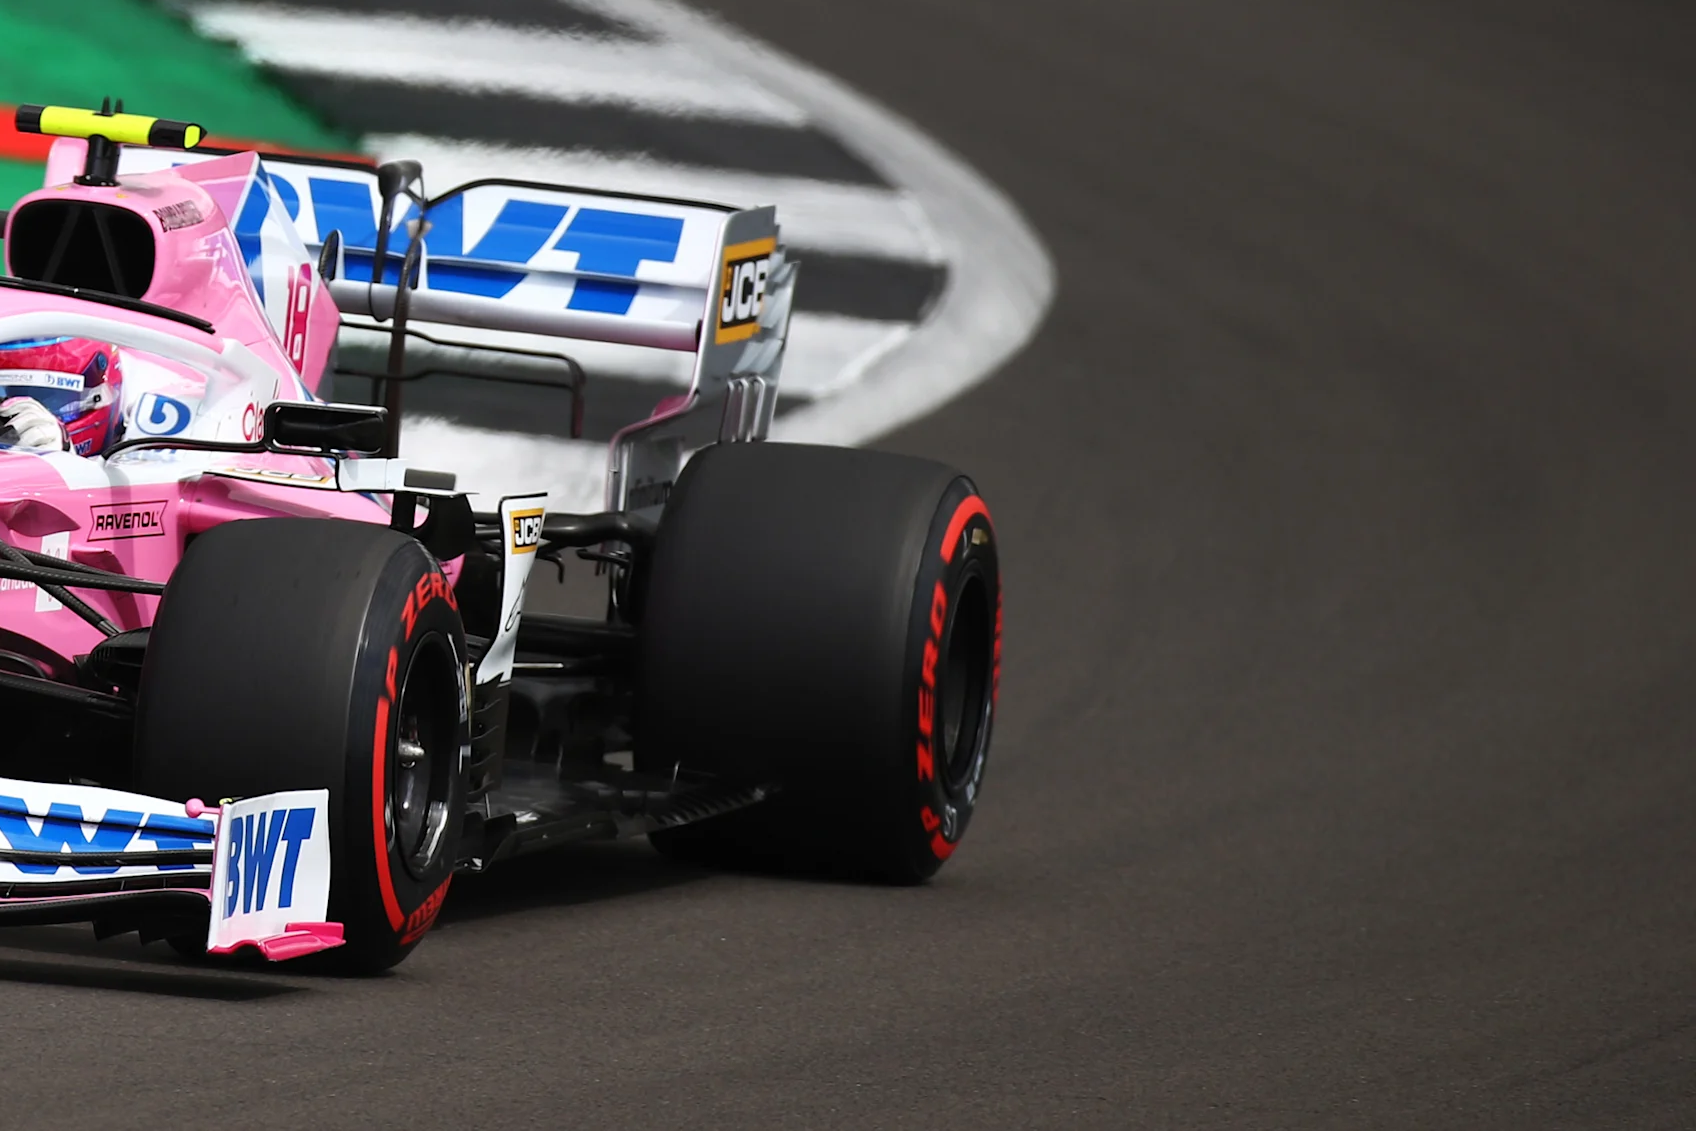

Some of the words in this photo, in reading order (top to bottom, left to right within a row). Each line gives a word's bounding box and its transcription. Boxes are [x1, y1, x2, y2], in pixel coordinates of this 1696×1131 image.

[56, 376, 81, 389] BWT
[242, 401, 265, 442] Cla
[74, 440, 92, 455] WT
[95, 511, 160, 531] RAVENOL
[515, 517, 541, 545] JCB
[917, 579, 949, 782] ZERO
[222, 806, 317, 920] BWT
